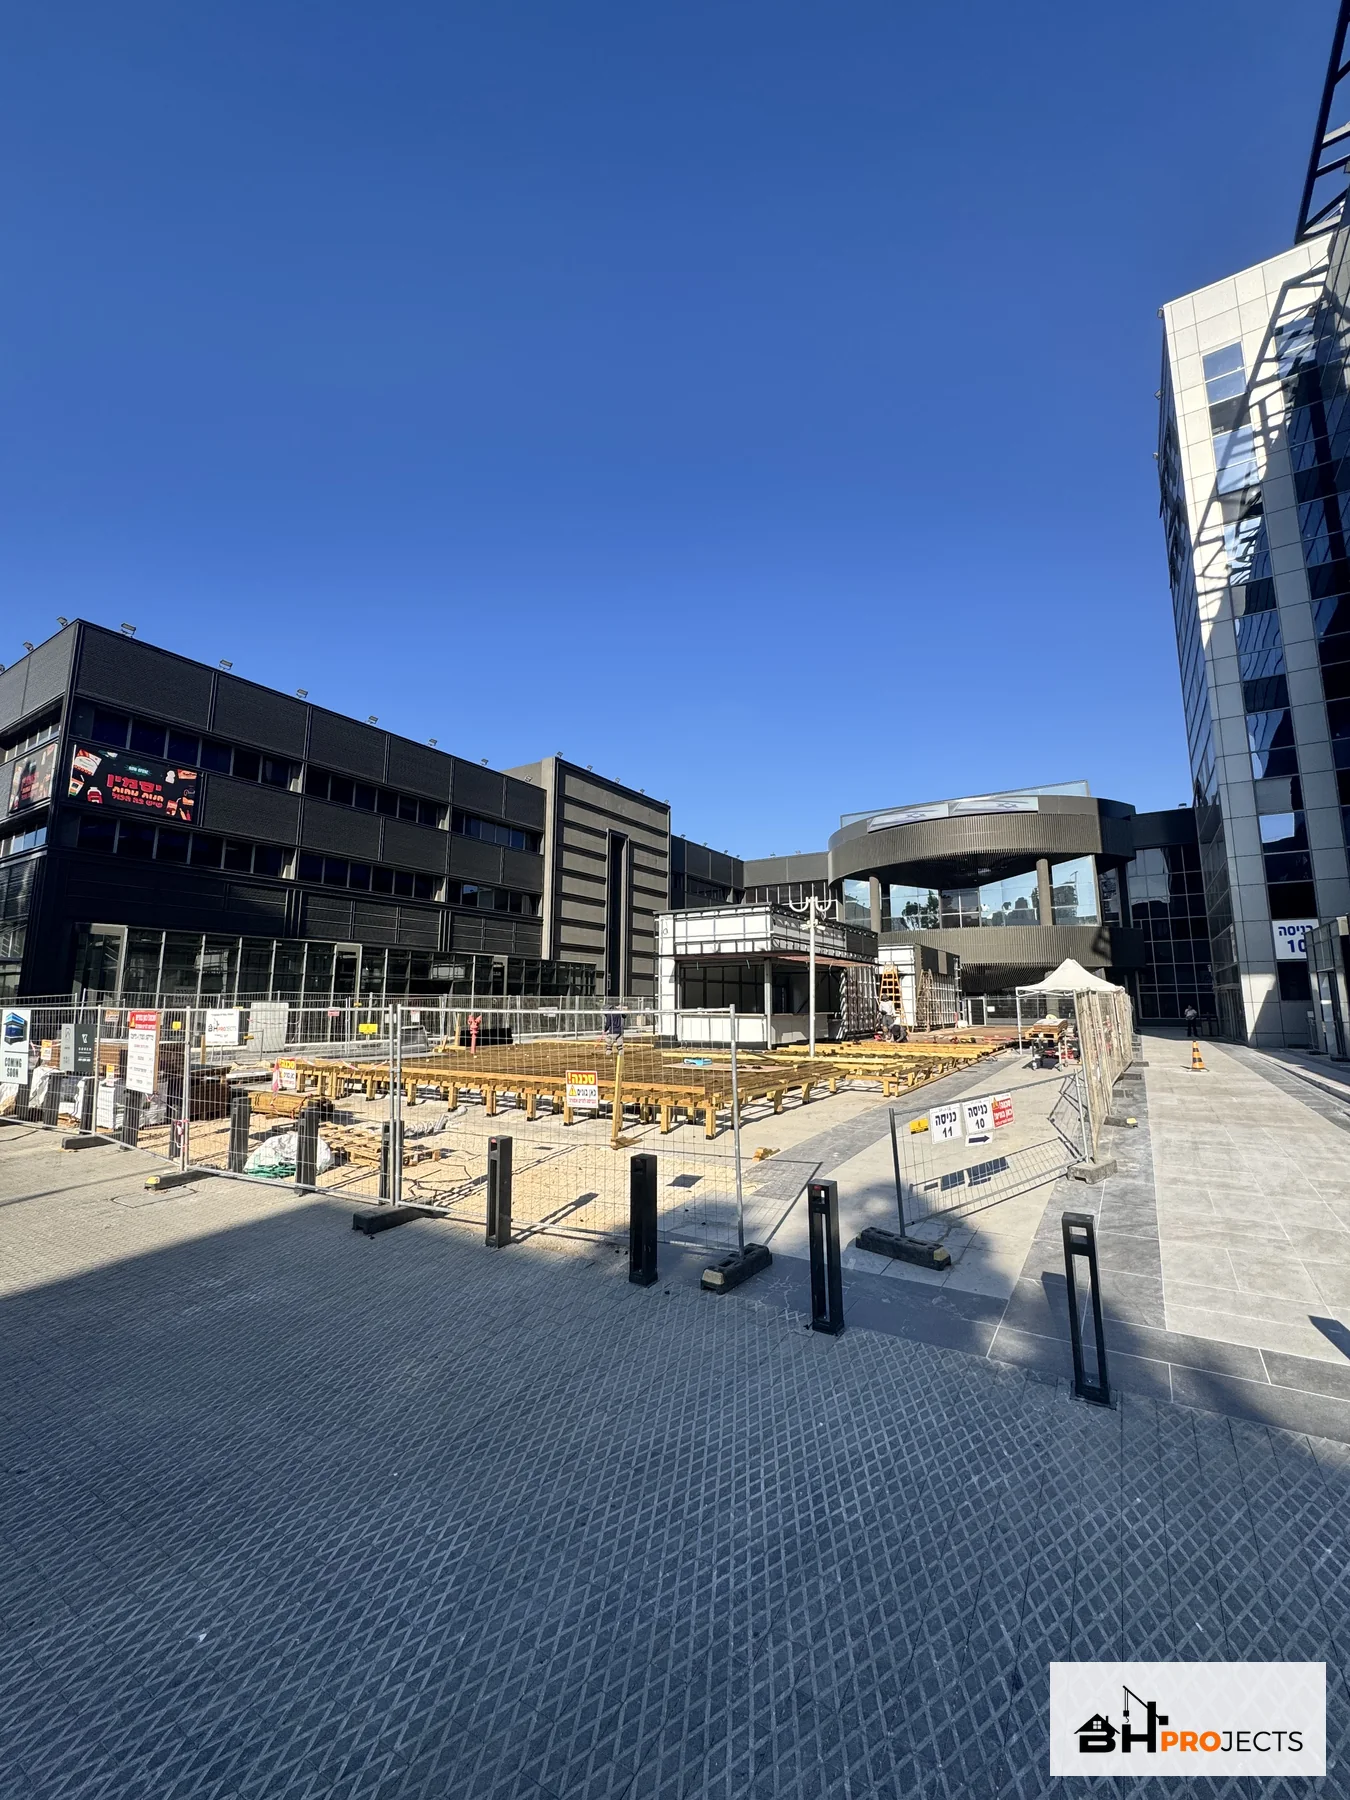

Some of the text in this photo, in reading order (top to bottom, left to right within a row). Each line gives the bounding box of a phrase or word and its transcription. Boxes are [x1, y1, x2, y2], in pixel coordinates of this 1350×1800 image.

[107, 774, 162, 792] יסמין
[112, 786, 164, 802] חנות נוחות
[146, 800, 163, 808] שיש
[4, 1057, 22, 1068] COMING
[7, 1068, 19, 1077] SOON
[568, 1072, 595, 1084] סכנה!
[968, 1104, 987, 1118] כניסה
[935, 1112, 957, 1126] כניסה
[976, 1118, 984, 1129] 10
[943, 1126, 952, 1138] 11
